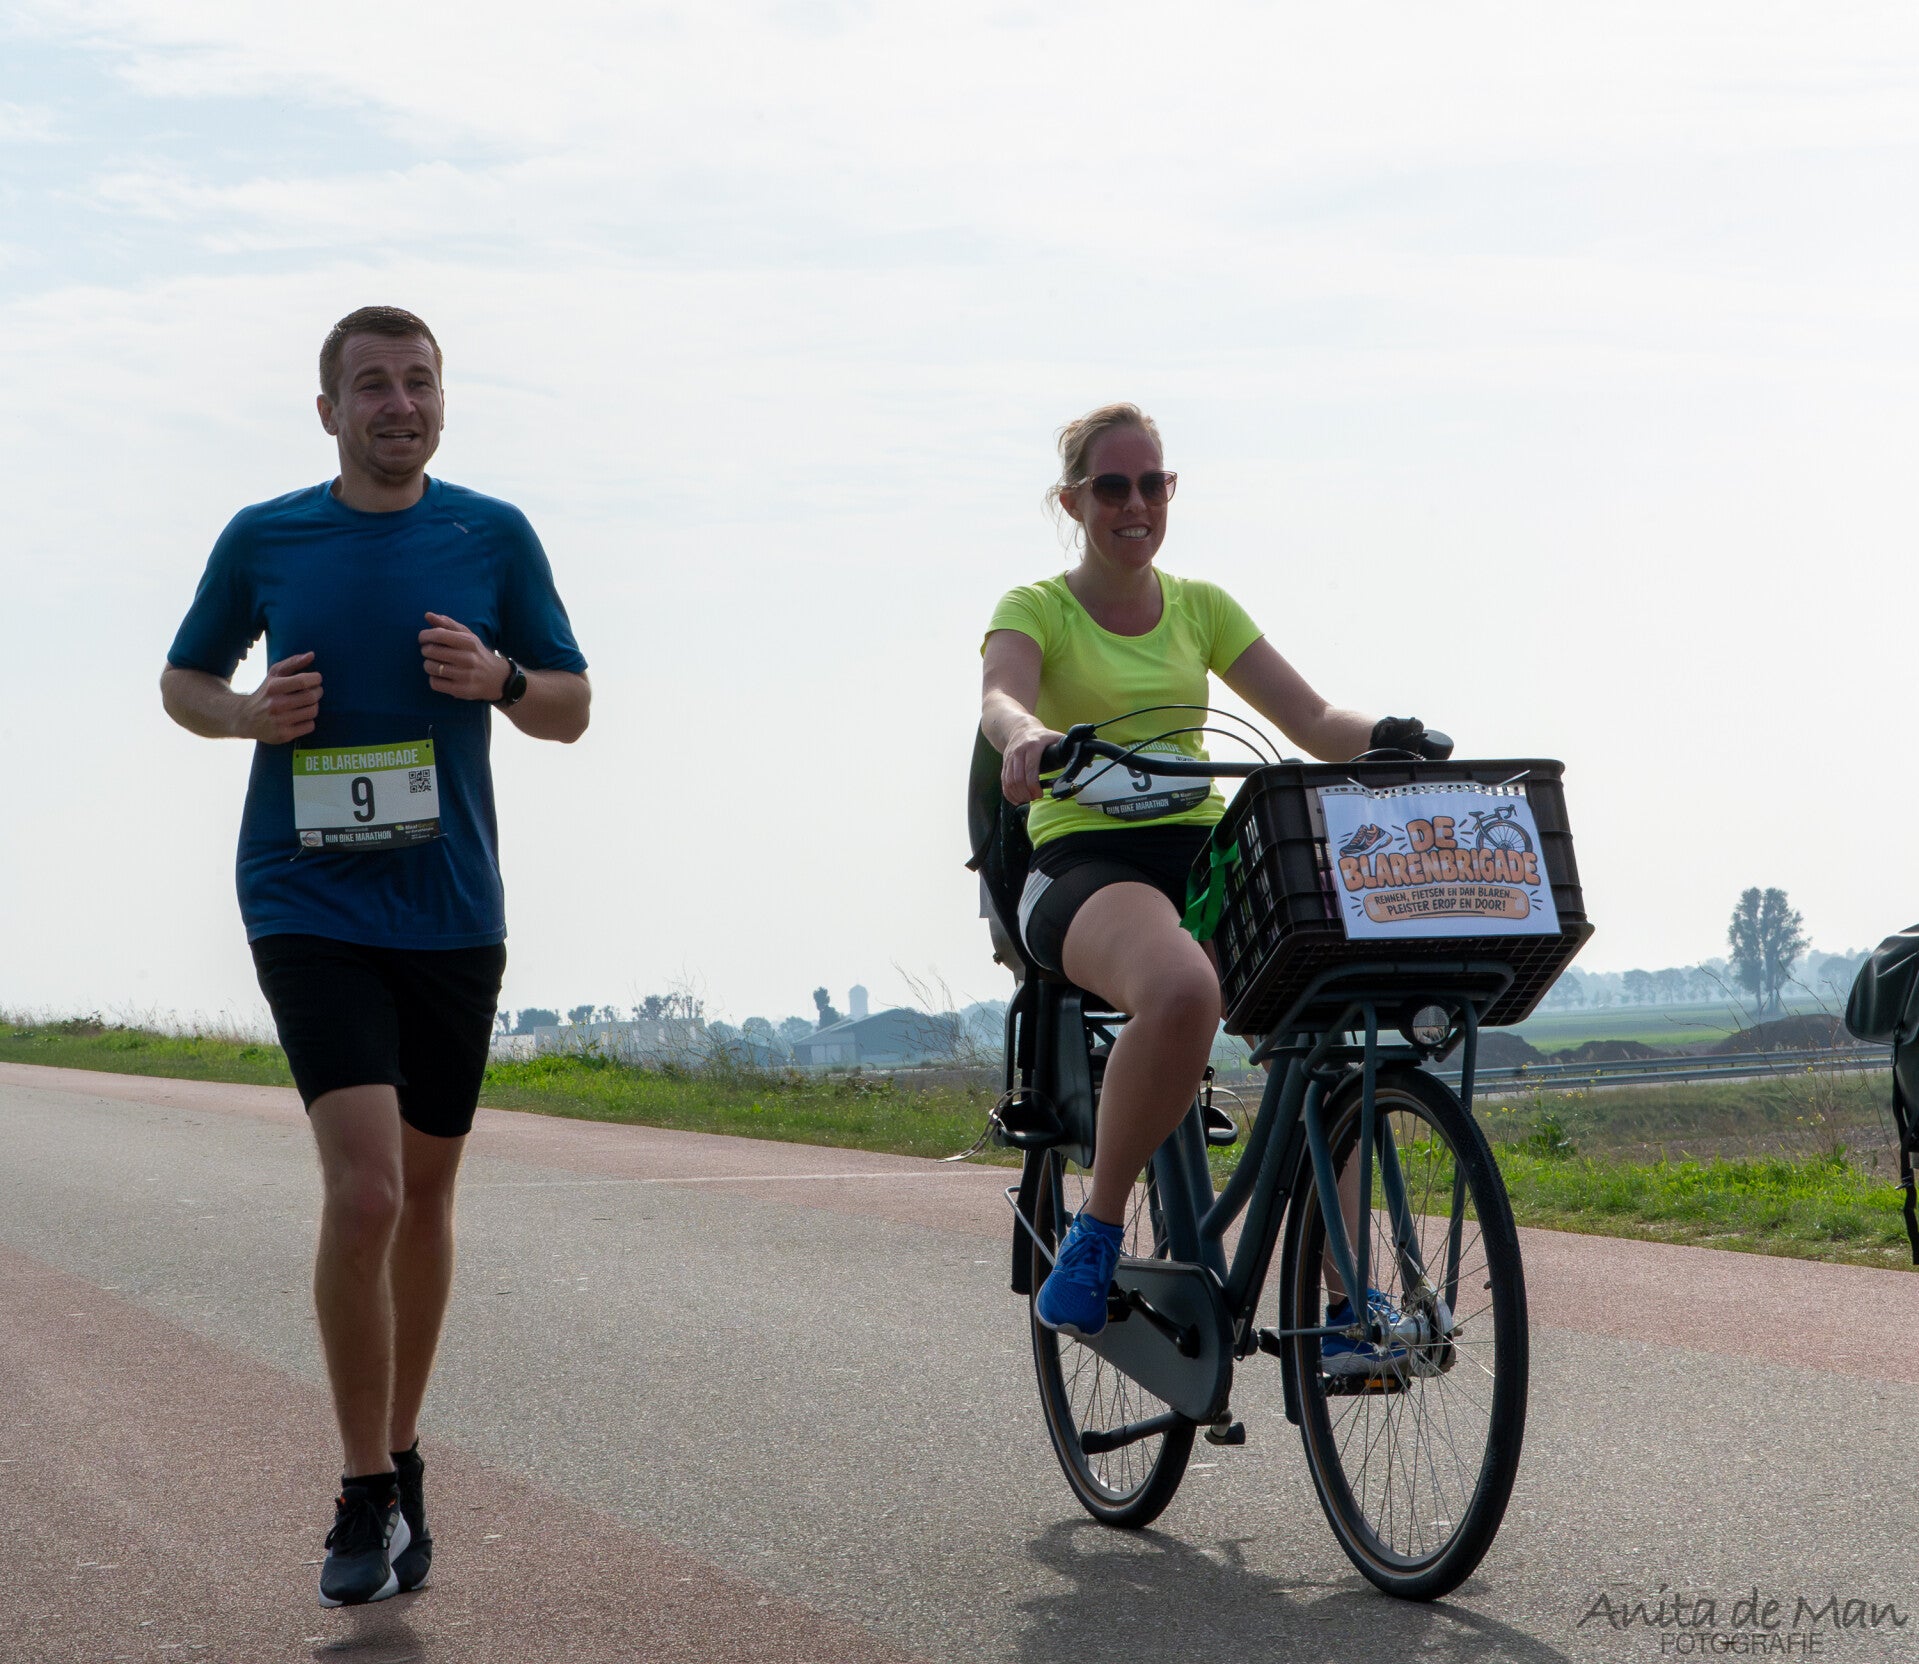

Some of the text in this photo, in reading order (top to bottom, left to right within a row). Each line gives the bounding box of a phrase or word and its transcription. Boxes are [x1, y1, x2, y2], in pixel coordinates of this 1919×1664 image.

[305, 748, 419, 771] DE BLARENBRIGADE
[351, 776, 376, 823] 9
[1106, 805, 1120, 815] RUN
[1120, 803, 1136, 813] BIKE
[1135, 798, 1170, 811] MARATHON
[325, 834, 339, 843] RUN
[339, 832, 355, 843] BIKE
[355, 830, 392, 842] MARATHON
[1405, 815, 1458, 853] DE
[1338, 848, 1541, 892] BLARENBRIGADE
[1374, 886, 1518, 906] RENNEN, FIETSEN EN DAN BLAREN...
[1386, 899, 1507, 916] PLEISTER EROP EN DOOR!
